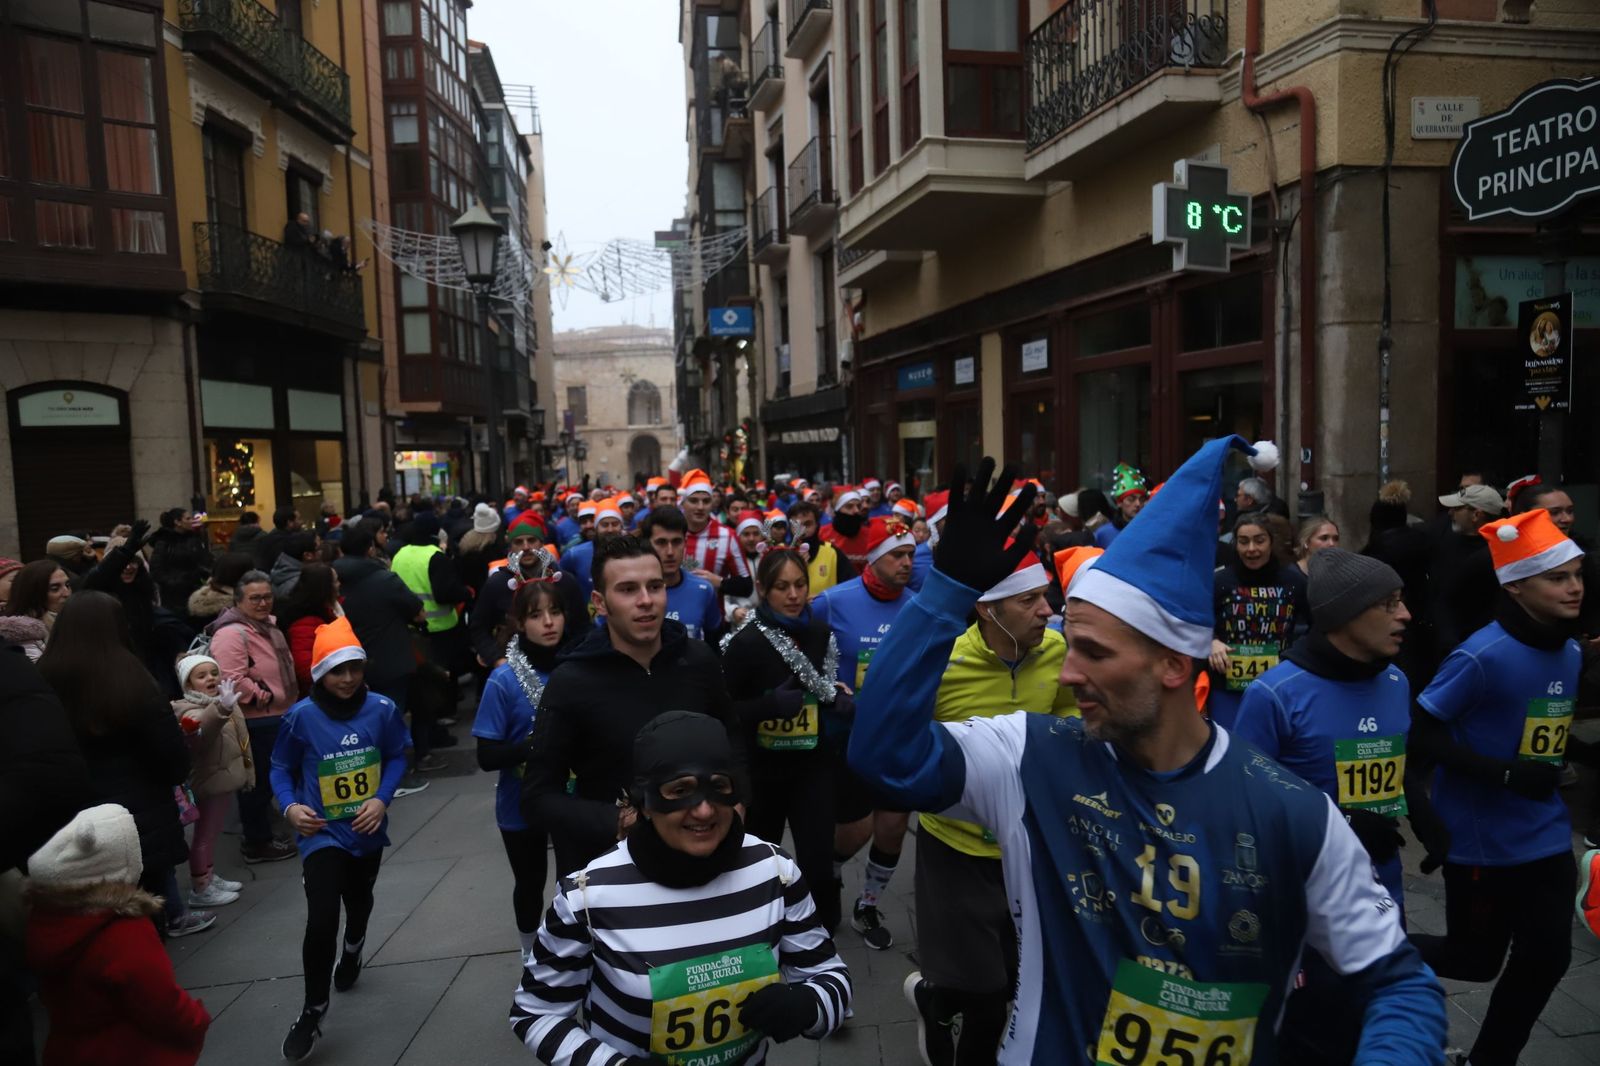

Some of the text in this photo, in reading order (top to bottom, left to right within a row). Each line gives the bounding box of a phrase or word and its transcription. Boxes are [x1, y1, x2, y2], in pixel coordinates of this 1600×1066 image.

[1436, 103, 1464, 112] CALLE
[1441, 114, 1453, 123] DE
[1492, 105, 1598, 158] TEATRO
[1478, 146, 1600, 200] PRINCIPA
[1187, 201, 1202, 229] 8
[1237, 586, 1284, 599] MERRY
[1547, 681, 1563, 695] 46
[1358, 717, 1378, 733] 46
[341, 733, 359, 746] 46
[1531, 725, 1569, 754] 62
[323, 753, 335, 761] SAN
[334, 771, 369, 800] 68
[1344, 761, 1396, 797] 1192
[1072, 793, 1123, 819] MERCURY
[1130, 844, 1201, 921] 19
[687, 965, 744, 985] CAJA RURAL
[1160, 990, 1230, 1012] CAJA RURAL
[665, 999, 745, 1051] 56
[1110, 1012, 1236, 1066] 956
